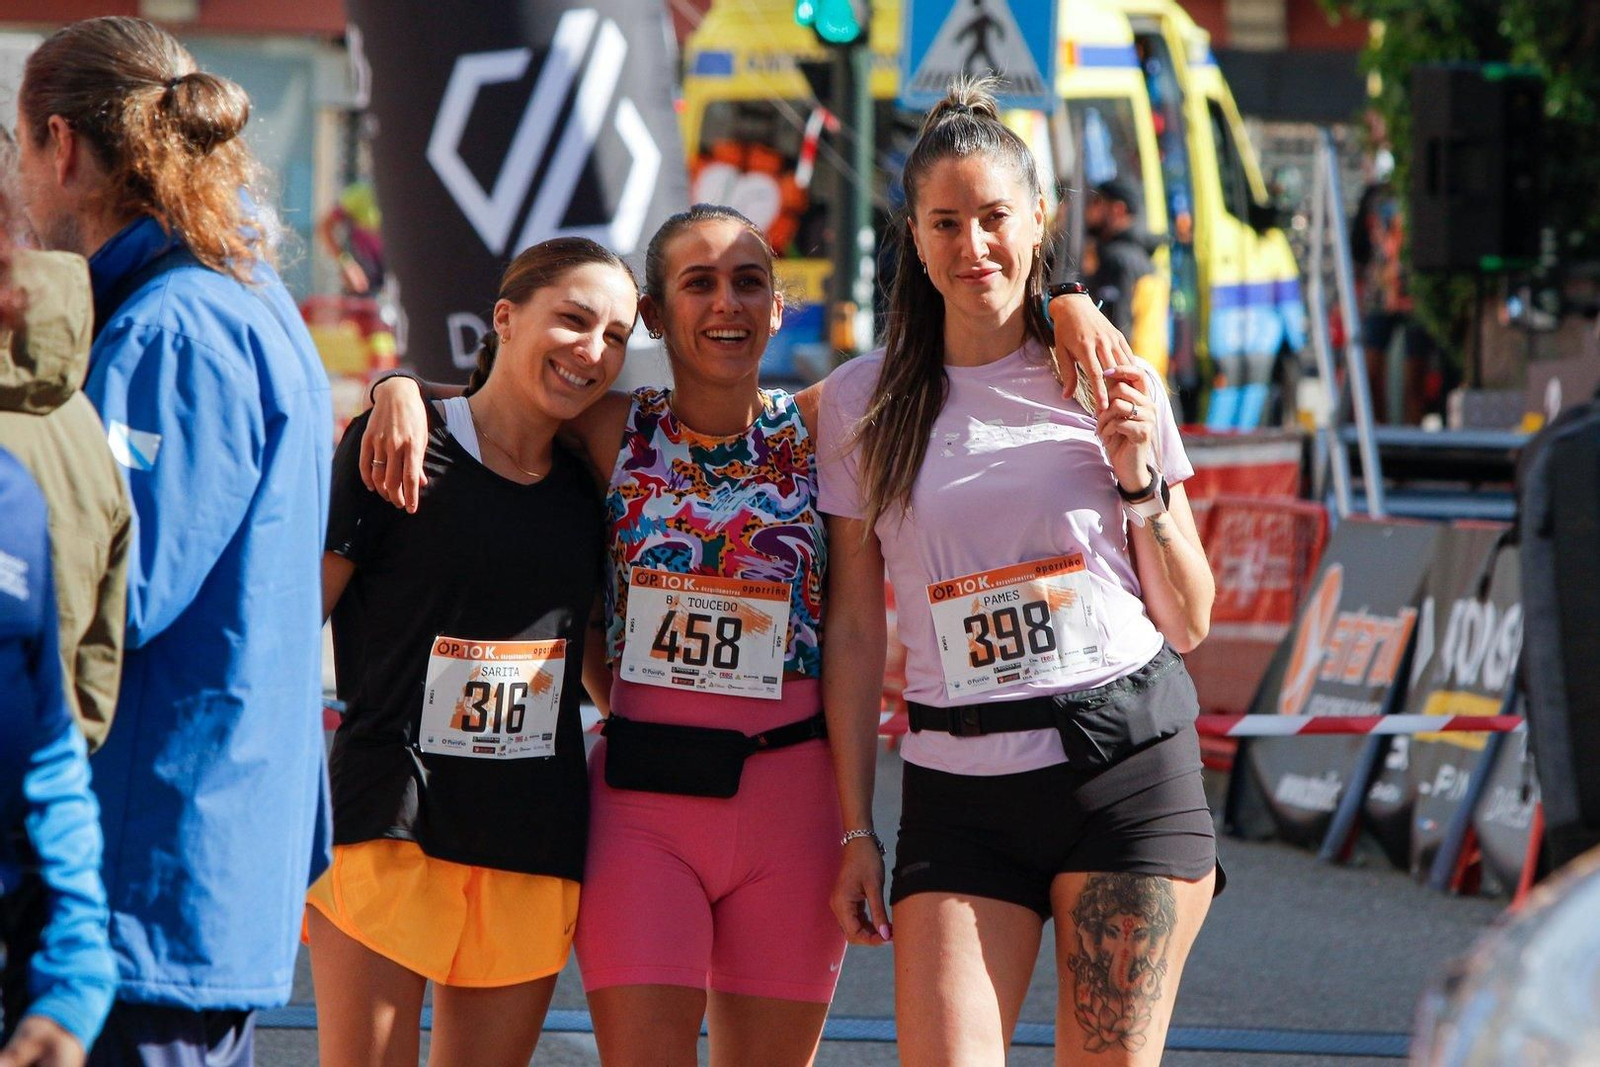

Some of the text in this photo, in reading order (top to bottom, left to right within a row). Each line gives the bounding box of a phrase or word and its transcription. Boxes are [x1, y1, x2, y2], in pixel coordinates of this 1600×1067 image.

[665, 594, 738, 612] B. TOUCEDO
[983, 589, 1020, 607] PAMES
[651, 609, 743, 670] 458
[963, 600, 1057, 668] 398
[480, 666, 521, 677] SARITA
[460, 681, 529, 734] 316
